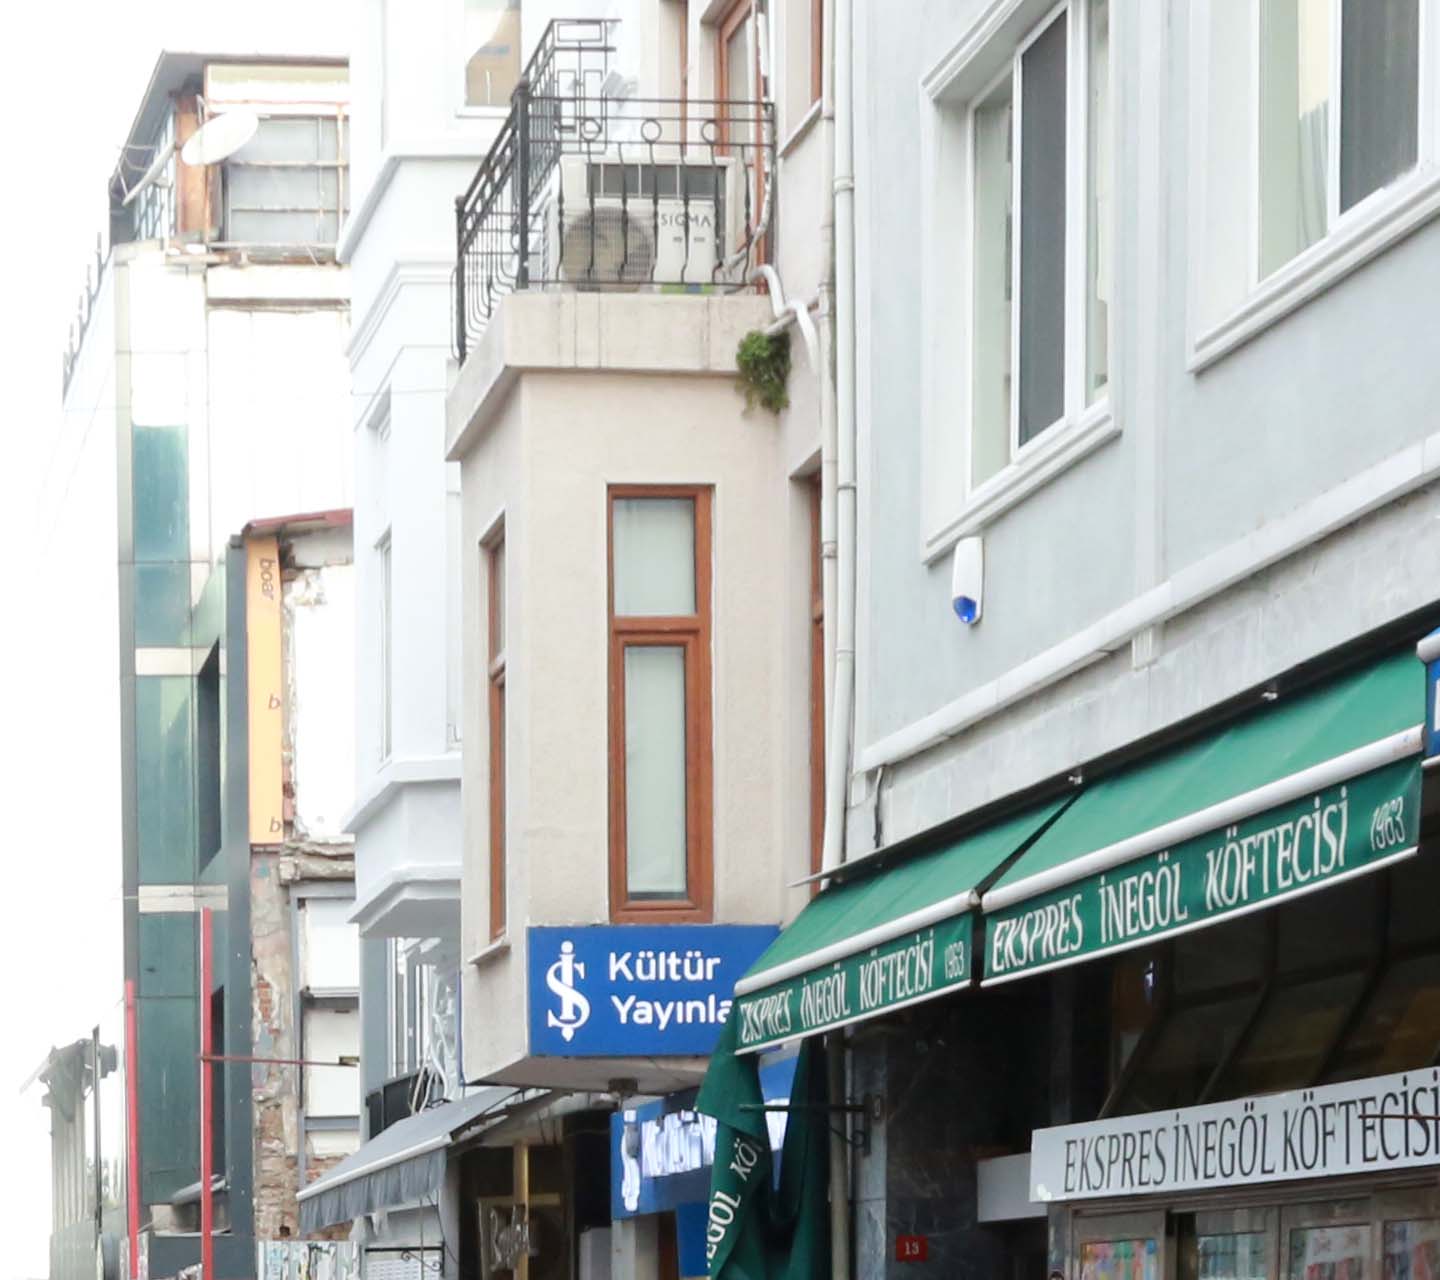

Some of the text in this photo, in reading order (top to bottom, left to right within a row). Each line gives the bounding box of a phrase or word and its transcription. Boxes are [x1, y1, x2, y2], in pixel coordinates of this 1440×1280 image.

[990, 785, 1406, 973] EKSPRES İNEGÖL KÖFTECİSİ 1963
[608, 950, 722, 982] Kültür
[611, 994, 734, 1031] Yayınla
[739, 928, 965, 1045] EKSPRES İNEGÖL KÖFTECİSİ 1963
[1062, 1127, 1168, 1195] EKSPRES
[1172, 1112, 1275, 1183] İNEGÖL
[1282, 1068, 1440, 1173] KÖFTECİSİ
